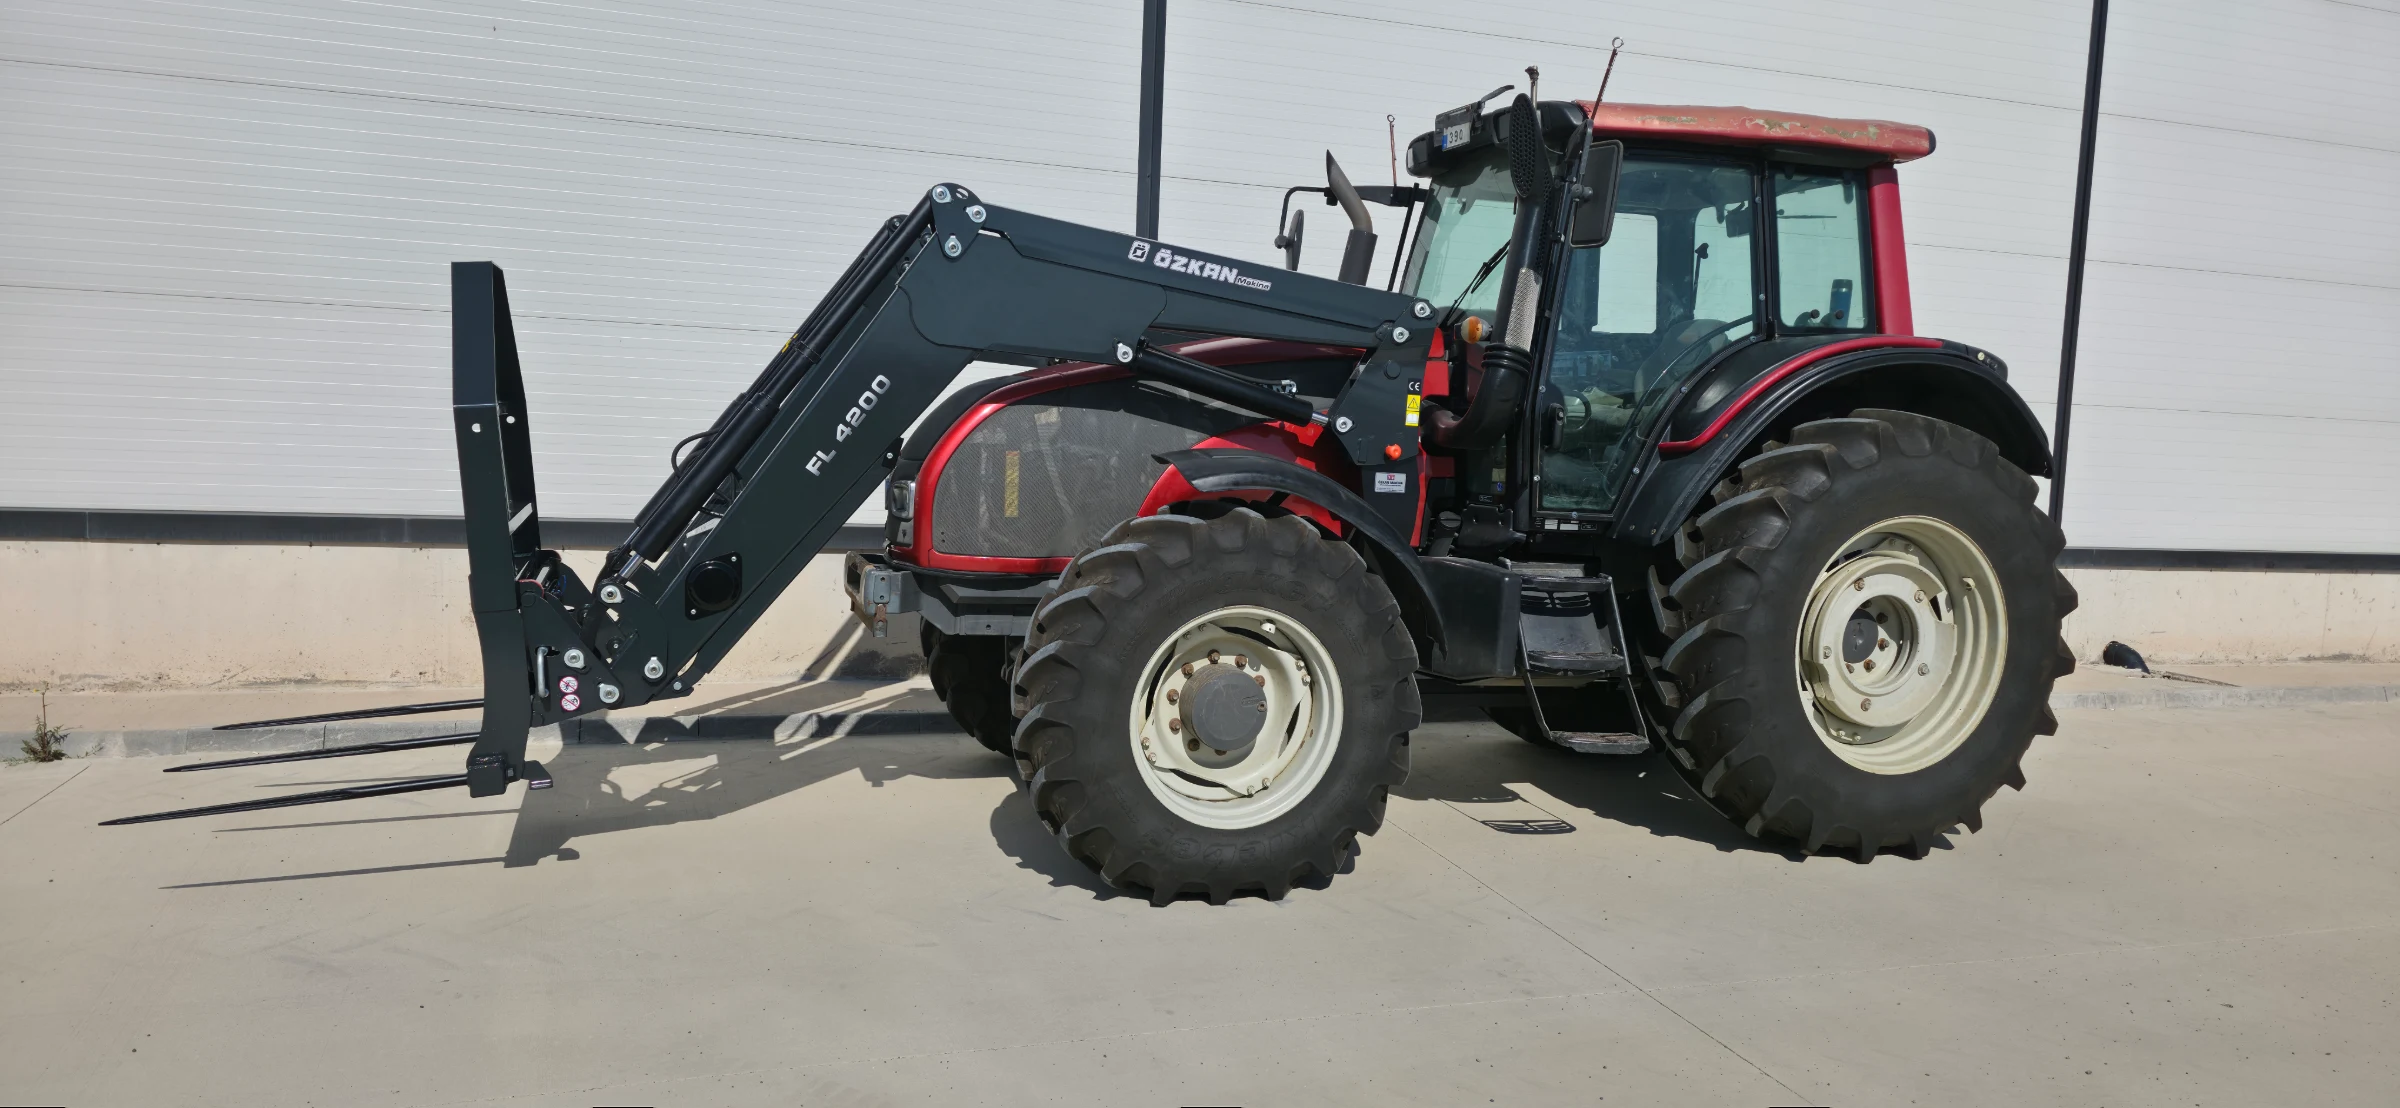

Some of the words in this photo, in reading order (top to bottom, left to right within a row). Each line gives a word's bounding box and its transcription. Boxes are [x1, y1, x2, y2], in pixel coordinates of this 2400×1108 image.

[1153, 248, 1239, 284] ÖZKAN
[1237, 276, 1270, 291] Makina
[805, 450, 837, 477] FL
[836, 374, 891, 442] 4200
